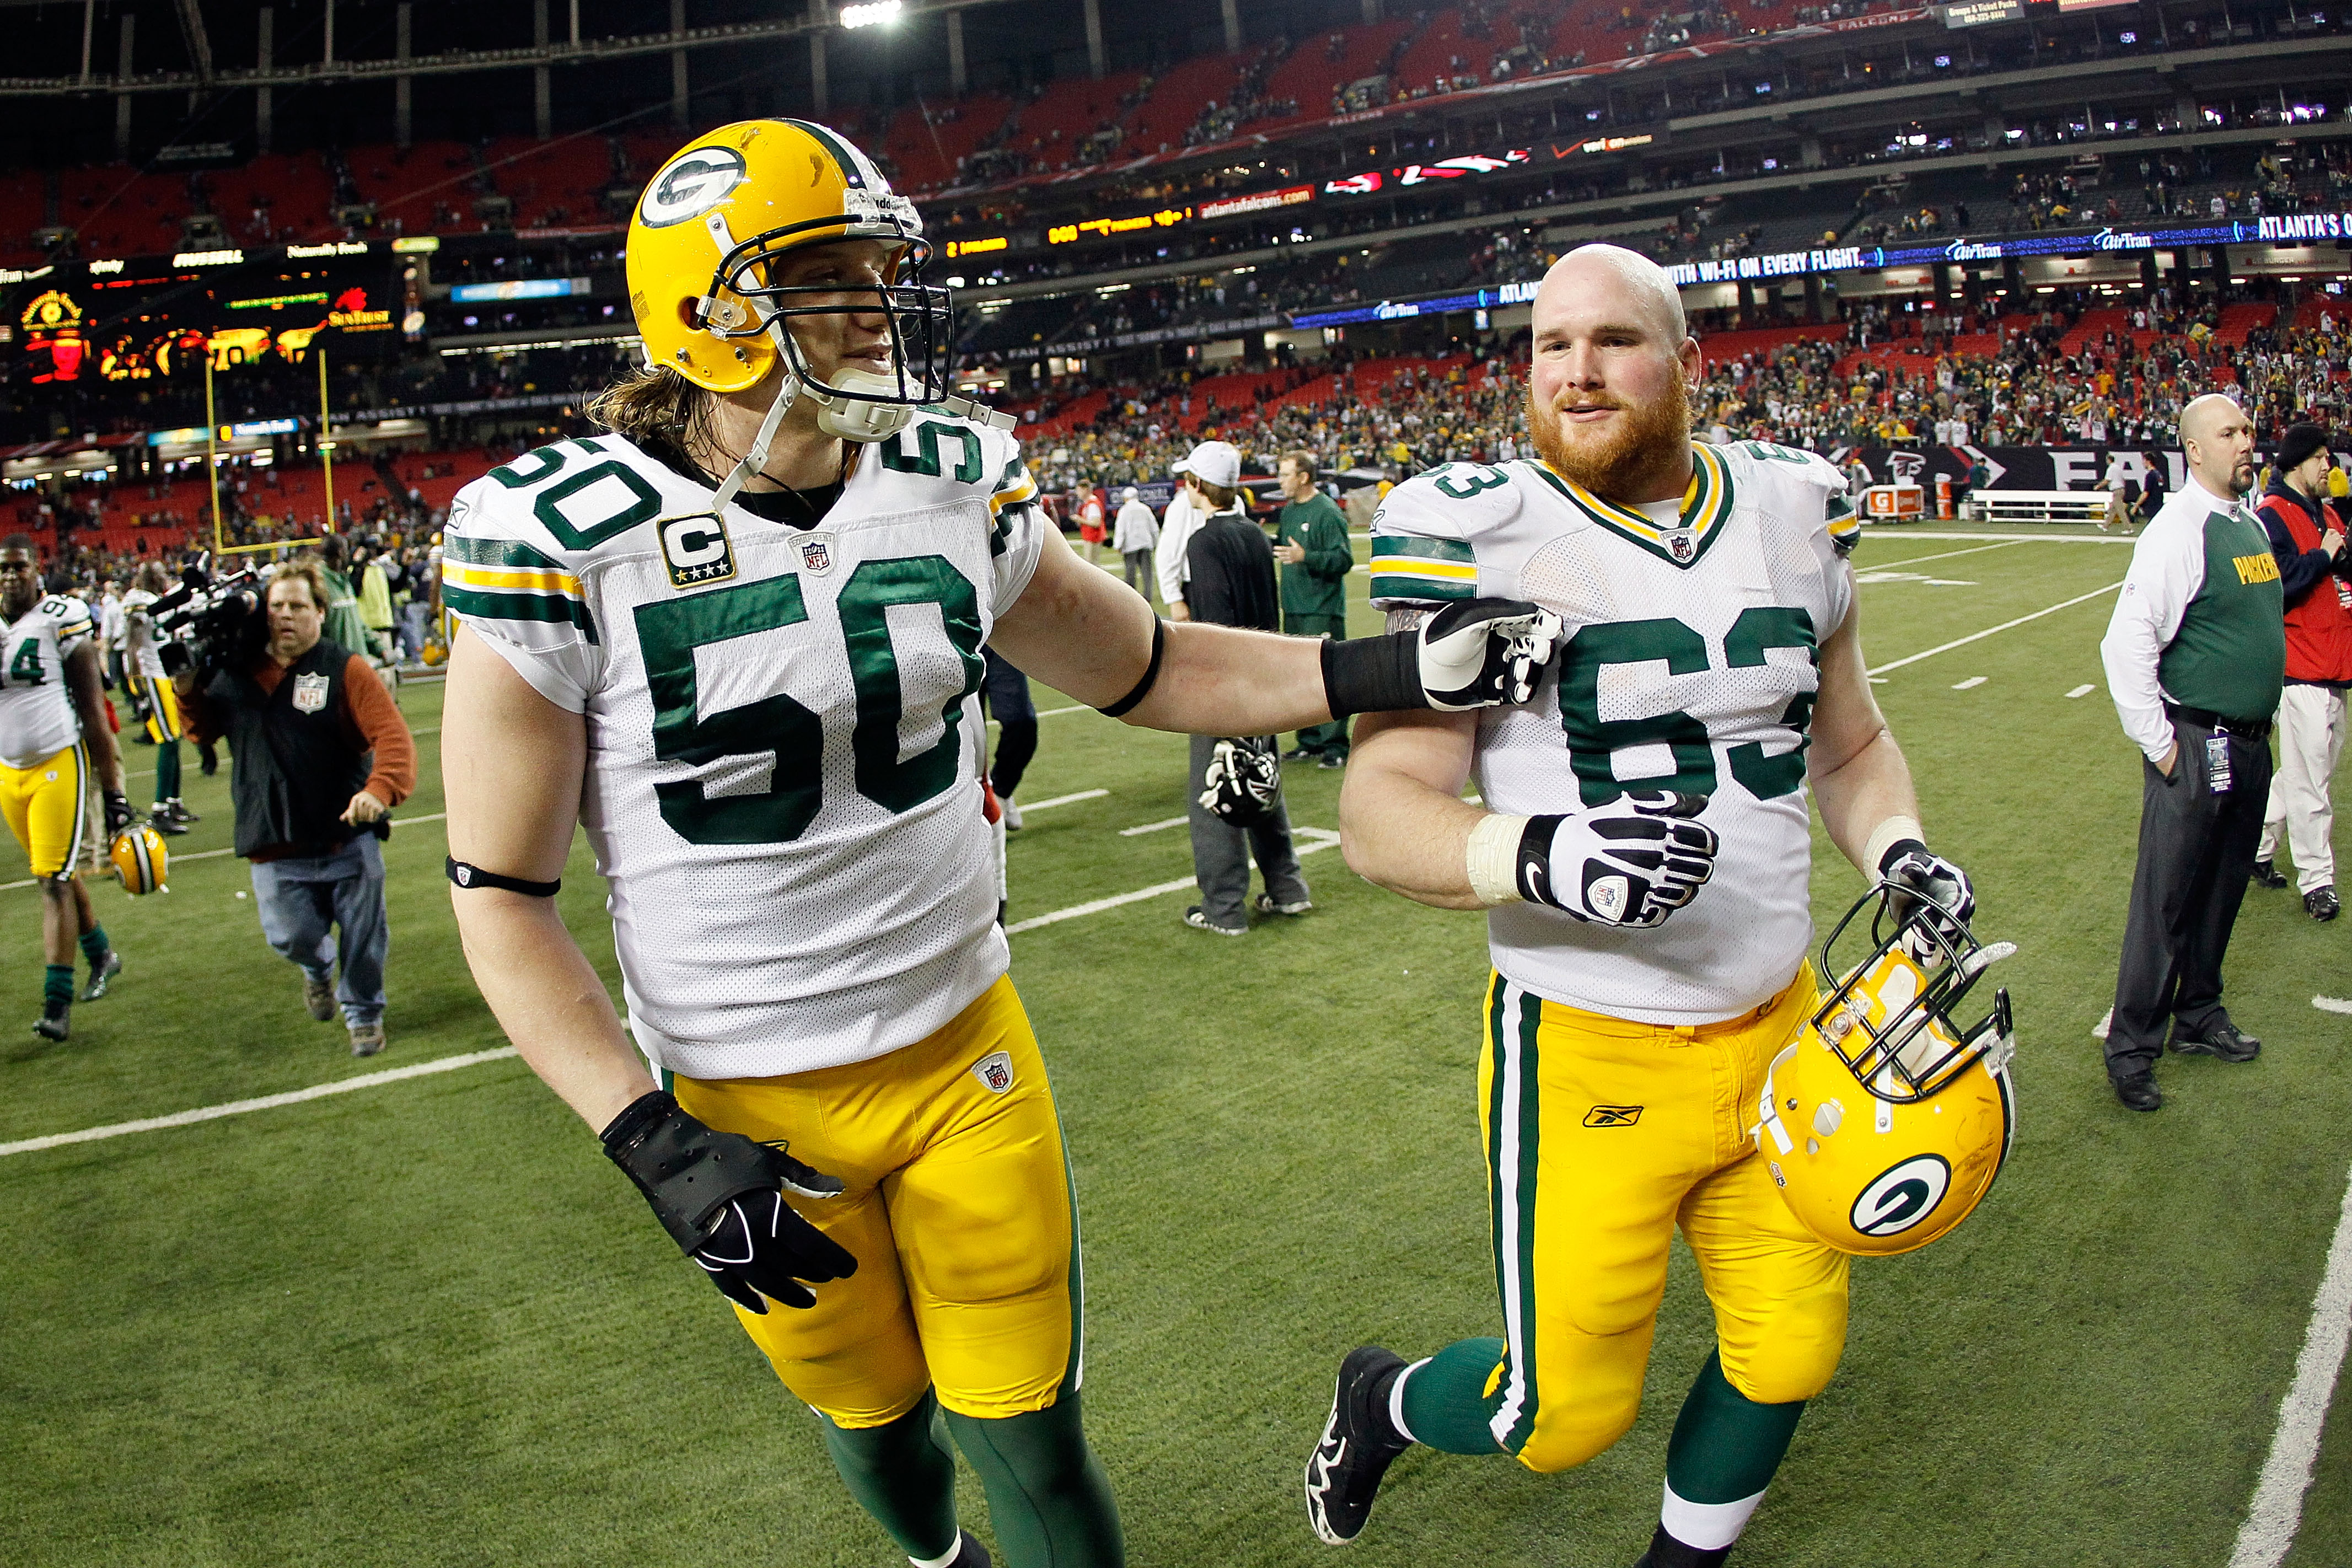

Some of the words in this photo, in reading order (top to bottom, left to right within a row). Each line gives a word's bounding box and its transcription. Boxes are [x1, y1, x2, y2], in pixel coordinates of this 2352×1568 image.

[2259, 213, 2340, 239] ATLANTA'S
[1698, 259, 1737, 282] WI-FI
[1738, 257, 1760, 278] ON
[1763, 251, 1807, 275] EVERY
[1809, 246, 1866, 271] FLIGHT.
[664, 517, 726, 567] C
[791, 534, 832, 547] EQUIPMENT
[1674, 544, 1690, 556] NFL
[807, 553, 828, 568] NFL
[633, 554, 984, 846] 50
[1558, 606, 1821, 808] 63
[1596, 886, 1608, 903] NFL
[1611, 882, 1623, 916] EQUIPMENT
[990, 1072, 1008, 1087] NFL
